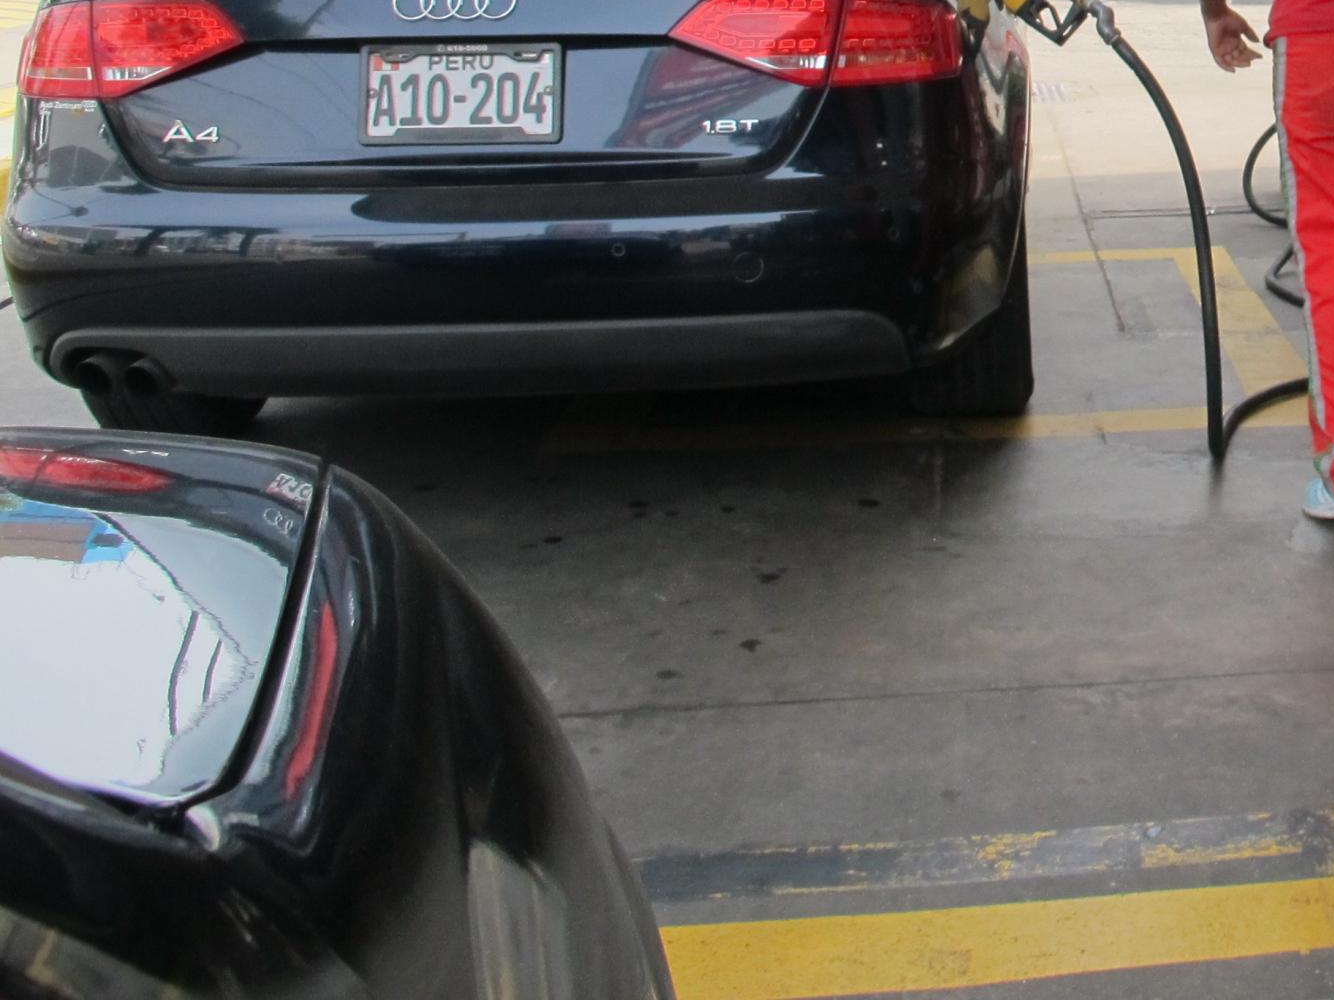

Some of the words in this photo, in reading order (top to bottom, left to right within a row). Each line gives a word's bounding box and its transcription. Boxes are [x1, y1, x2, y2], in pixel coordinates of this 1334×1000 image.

[428, 55, 494, 71] PERU
[372, 71, 547, 127] A10-204
[163, 119, 220, 143] A4
[702, 119, 760, 134] 1.8T
